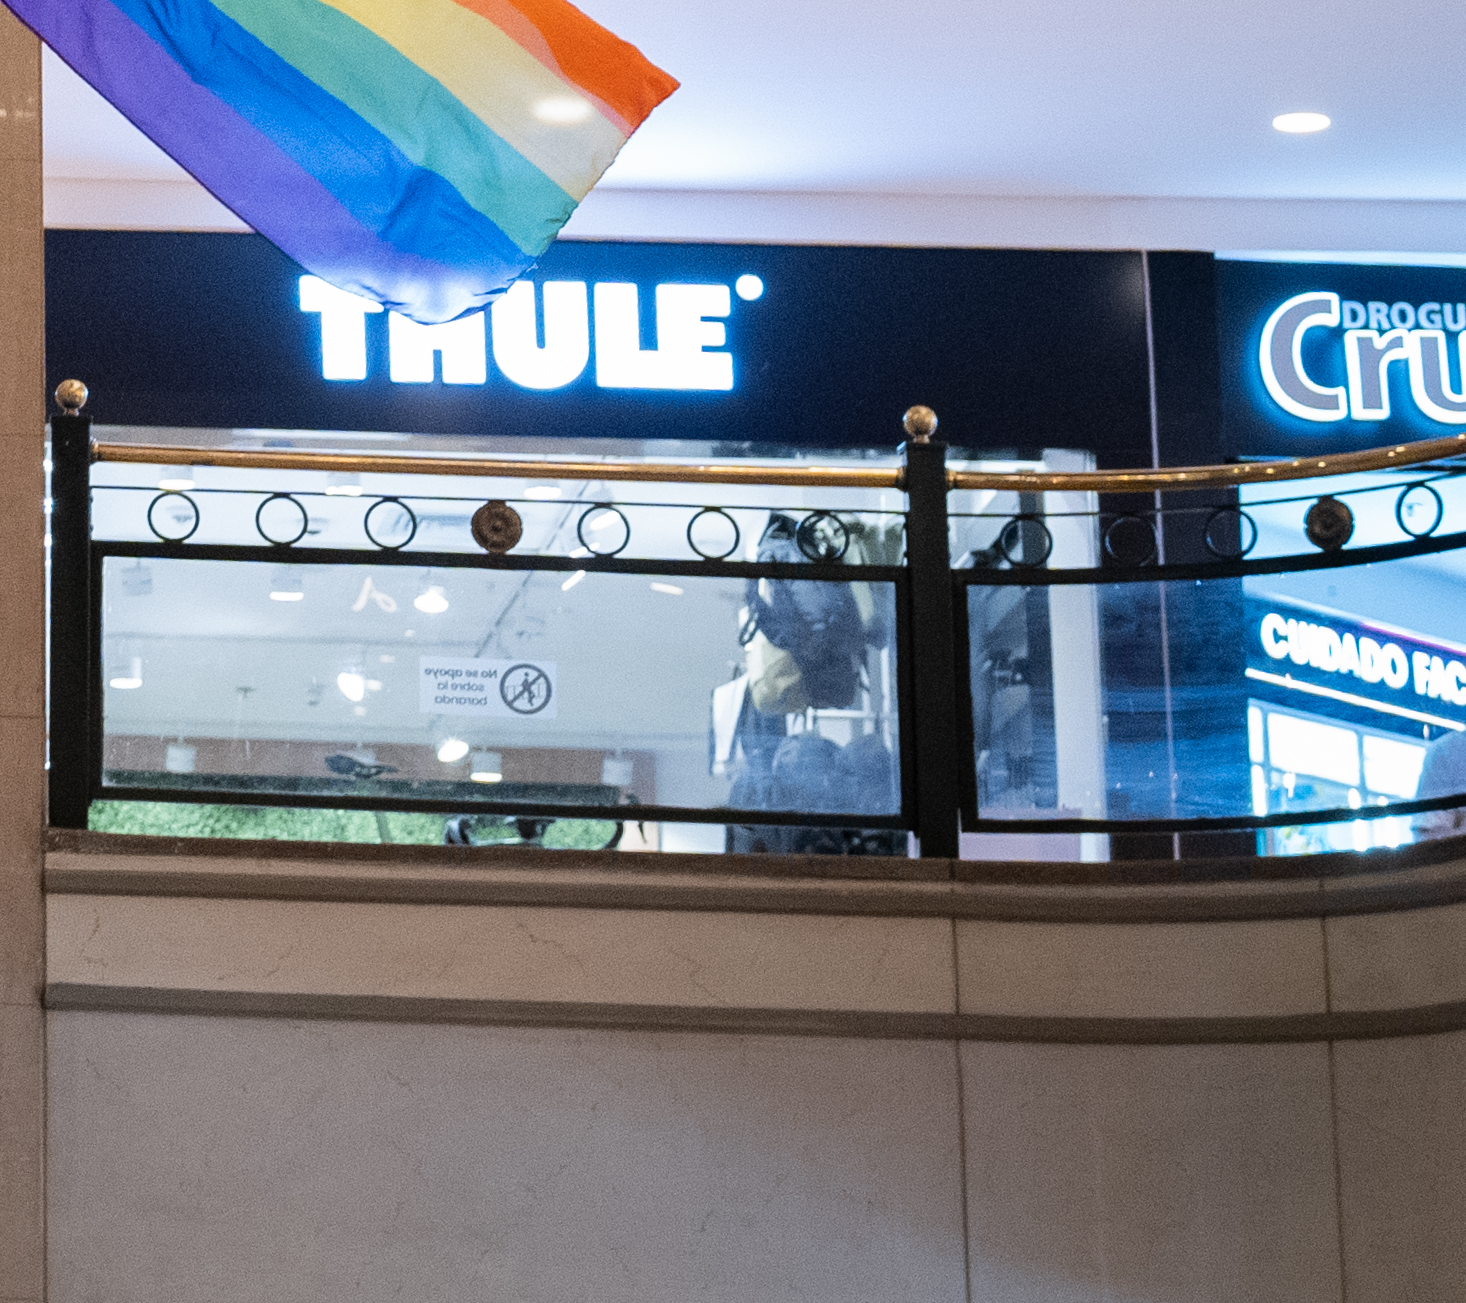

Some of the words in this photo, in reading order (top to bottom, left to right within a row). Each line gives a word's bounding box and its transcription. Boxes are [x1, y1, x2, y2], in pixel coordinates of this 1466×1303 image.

[298, 274, 734, 391] THULE
[1342, 300, 1466, 331] DROGU
[1260, 612, 1407, 691] CUIDADO
